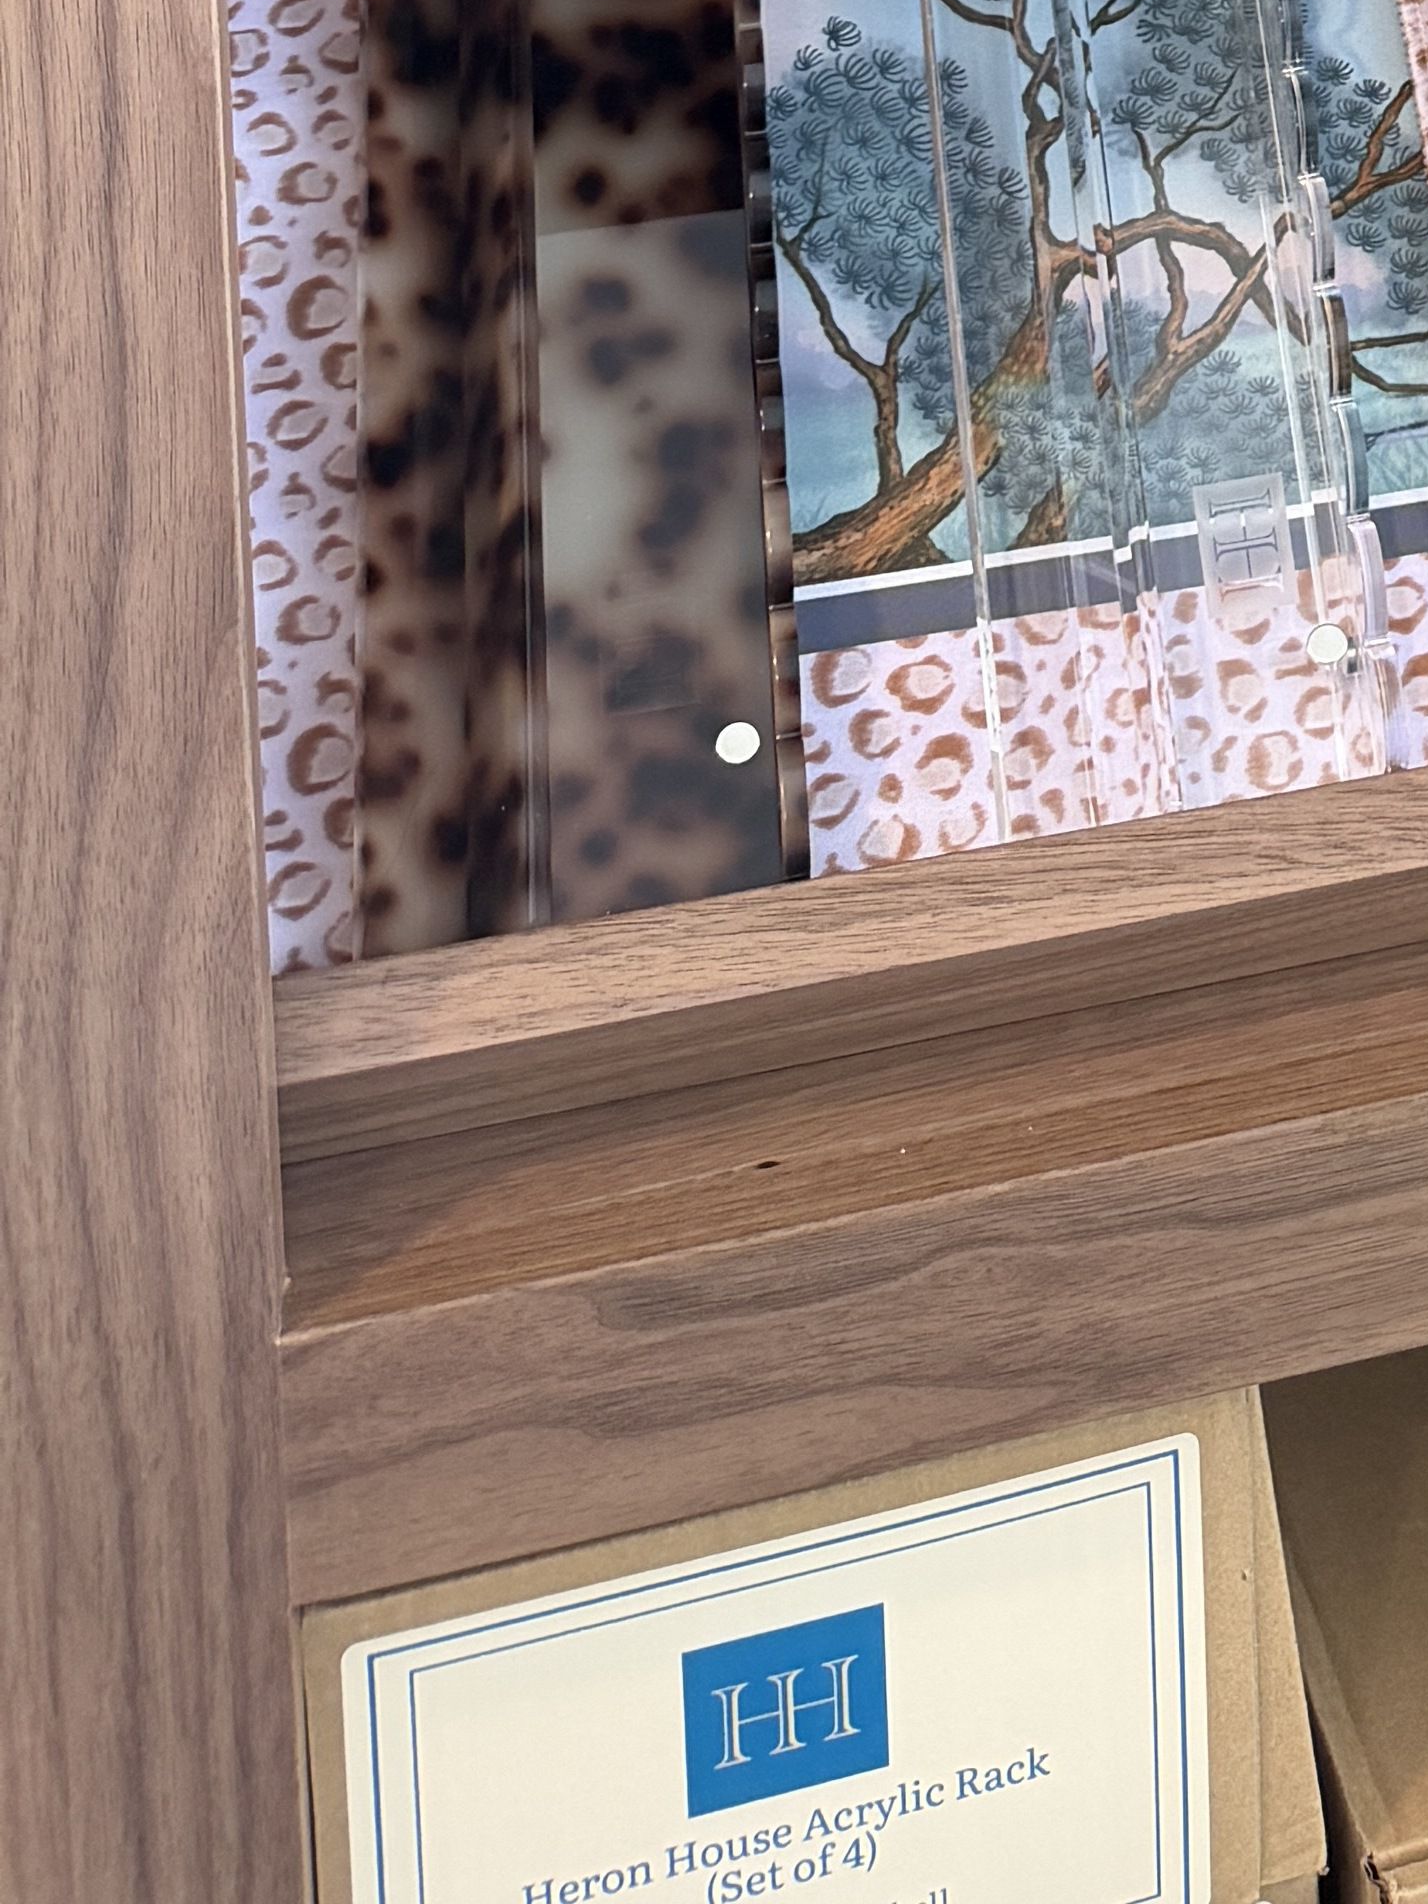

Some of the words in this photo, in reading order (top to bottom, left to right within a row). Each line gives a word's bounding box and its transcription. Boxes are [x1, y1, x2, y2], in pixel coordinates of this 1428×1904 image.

[521, 1856, 655, 1904] Heron
[665, 1824, 793, 1880] House
[802, 1778, 945, 1845] Acrylic
[954, 1747, 1052, 1801] Rack
[706, 1861, 785, 1904] (Set
[794, 1841, 836, 1885] of
[841, 1831, 878, 1872] 4)
